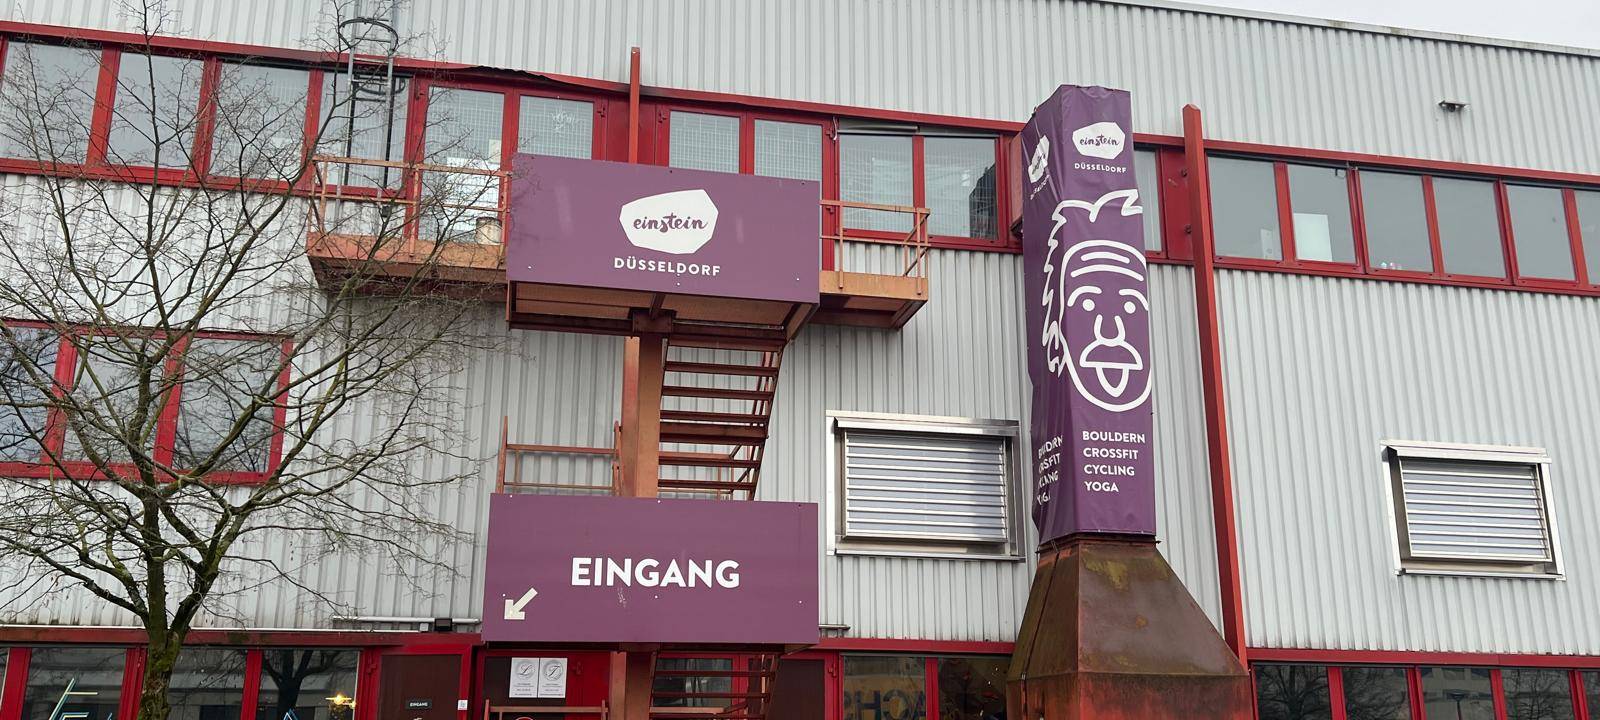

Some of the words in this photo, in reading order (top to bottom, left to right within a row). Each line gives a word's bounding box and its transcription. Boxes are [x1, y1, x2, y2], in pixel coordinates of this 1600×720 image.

[1079, 133, 1120, 147] einstein
[1074, 161, 1127, 174] DÜSSELDORF
[632, 211, 708, 234] einstein
[614, 255, 721, 276] DÜSSELDORF
[1082, 430, 1146, 444] BOULDERN
[1083, 447, 1139, 460] CROSSFIT
[1083, 464, 1135, 477] CYCLING
[1084, 481, 1119, 493] YOGA
[570, 557, 740, 589] EINGANG
